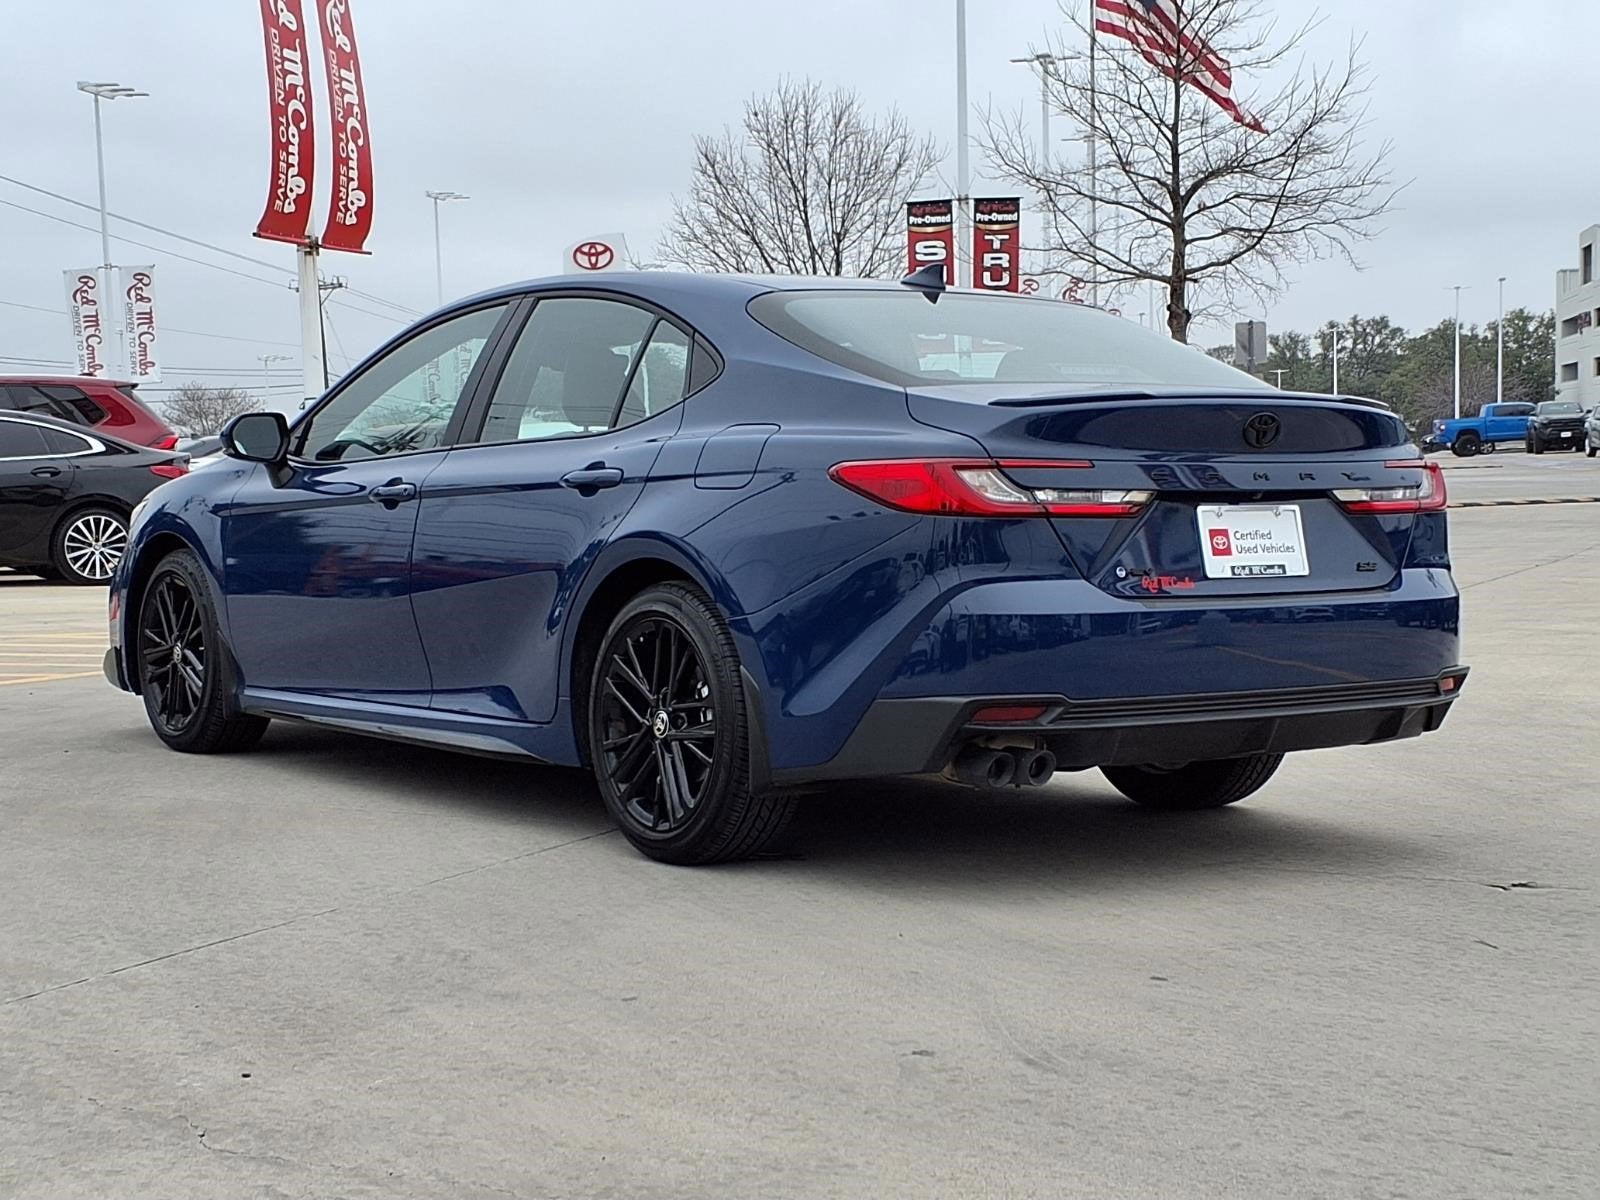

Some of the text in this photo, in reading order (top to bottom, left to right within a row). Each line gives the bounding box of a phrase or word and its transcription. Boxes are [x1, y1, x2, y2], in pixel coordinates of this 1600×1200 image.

[270, 26, 285, 106] DRIVEN
[277, 114, 287, 143] TO
[283, 38, 307, 214] McCombs
[328, 48, 348, 225] DRIVEN TO SERVE
[340, 59, 366, 226] McCombs
[274, 148, 287, 213] SERVE
[908, 213, 951, 225] Pre-Owned
[975, 212, 1018, 222] Pre-Owned
[72, 275, 104, 374] Red McComb
[72, 305, 86, 374] DRIVEN TO SERV
[125, 302, 138, 376] DRIVEN TO SERVE
[126, 272, 156, 377] Red McCombs
[1233, 529, 1272, 541] Certified
[1235, 543, 1295, 554] Used Vehicles
